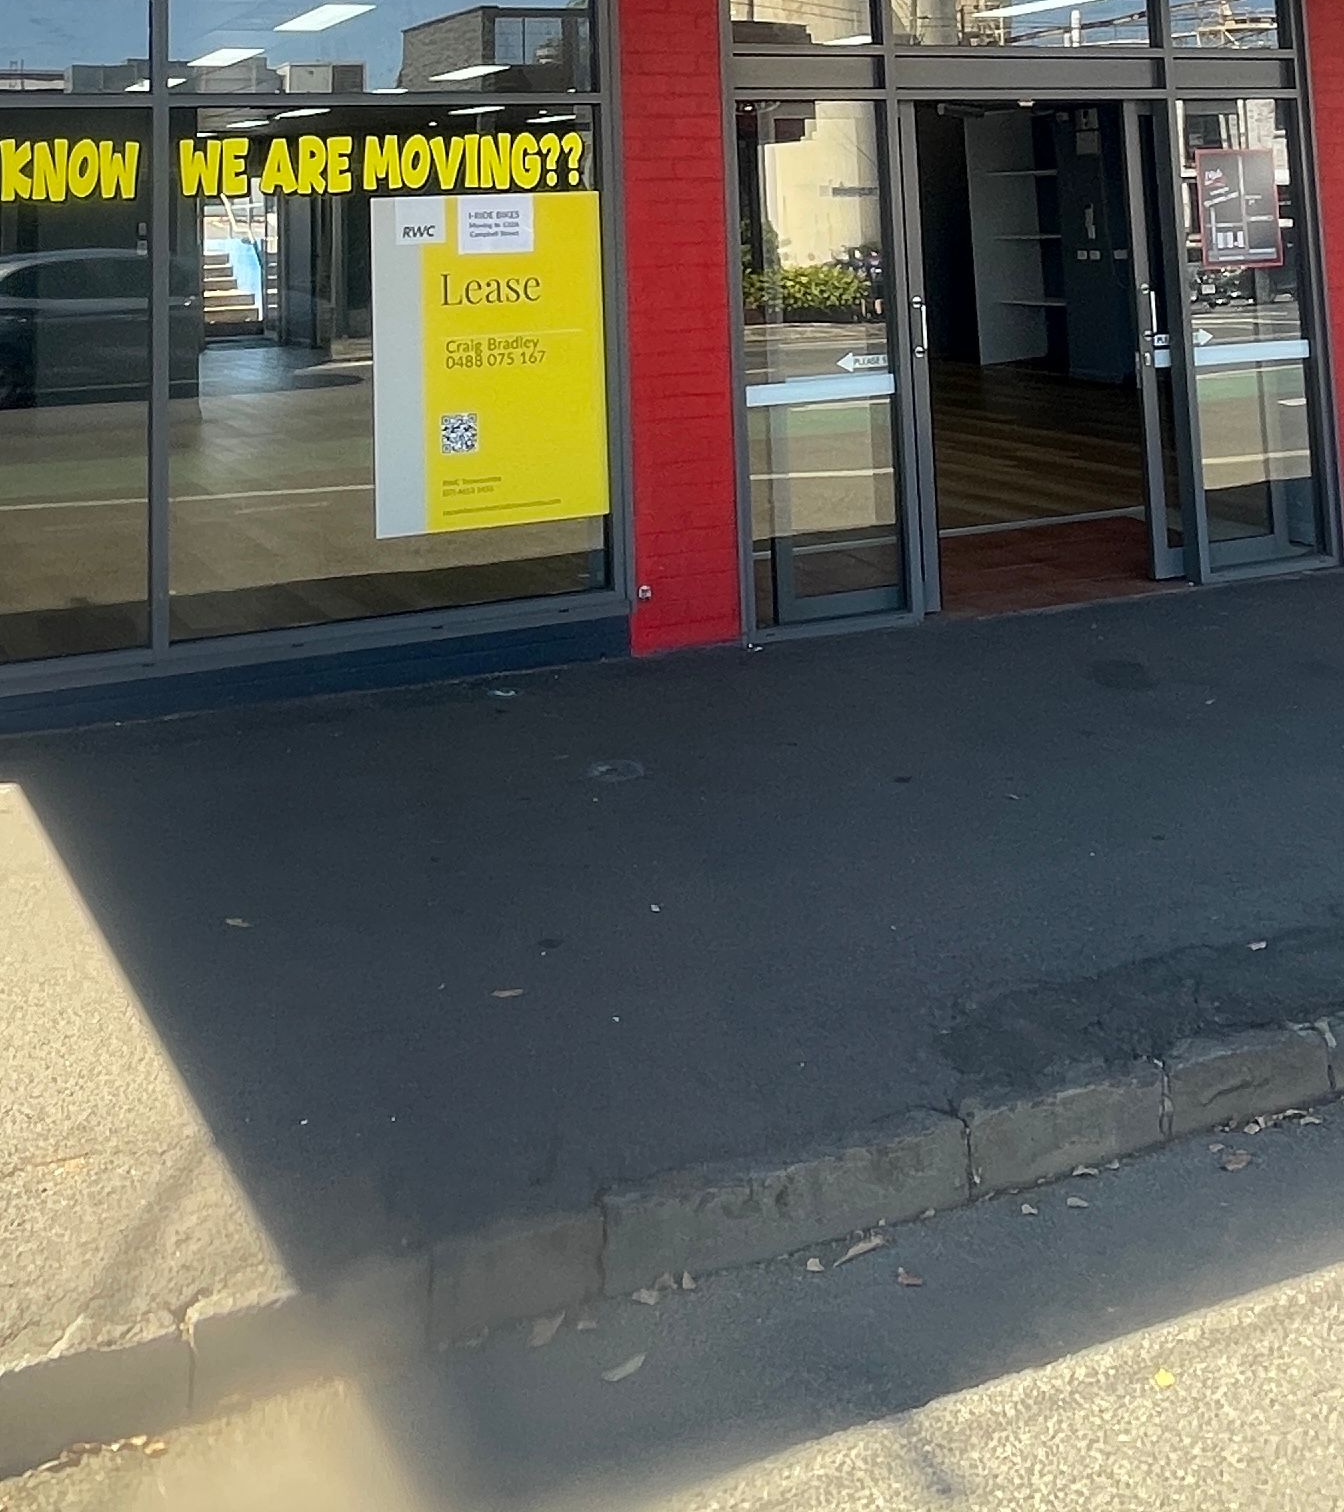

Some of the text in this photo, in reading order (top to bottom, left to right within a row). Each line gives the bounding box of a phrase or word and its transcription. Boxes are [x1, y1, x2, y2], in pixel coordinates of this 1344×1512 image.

[0, 138, 140, 202] KNOW
[179, 131, 583, 196] WE ARE MOVING??
[402, 224, 436, 239] RWC
[440, 273, 542, 307] Lease
[445, 335, 540, 357] Craig Bradley
[445, 350, 546, 370] 0488 075 167
